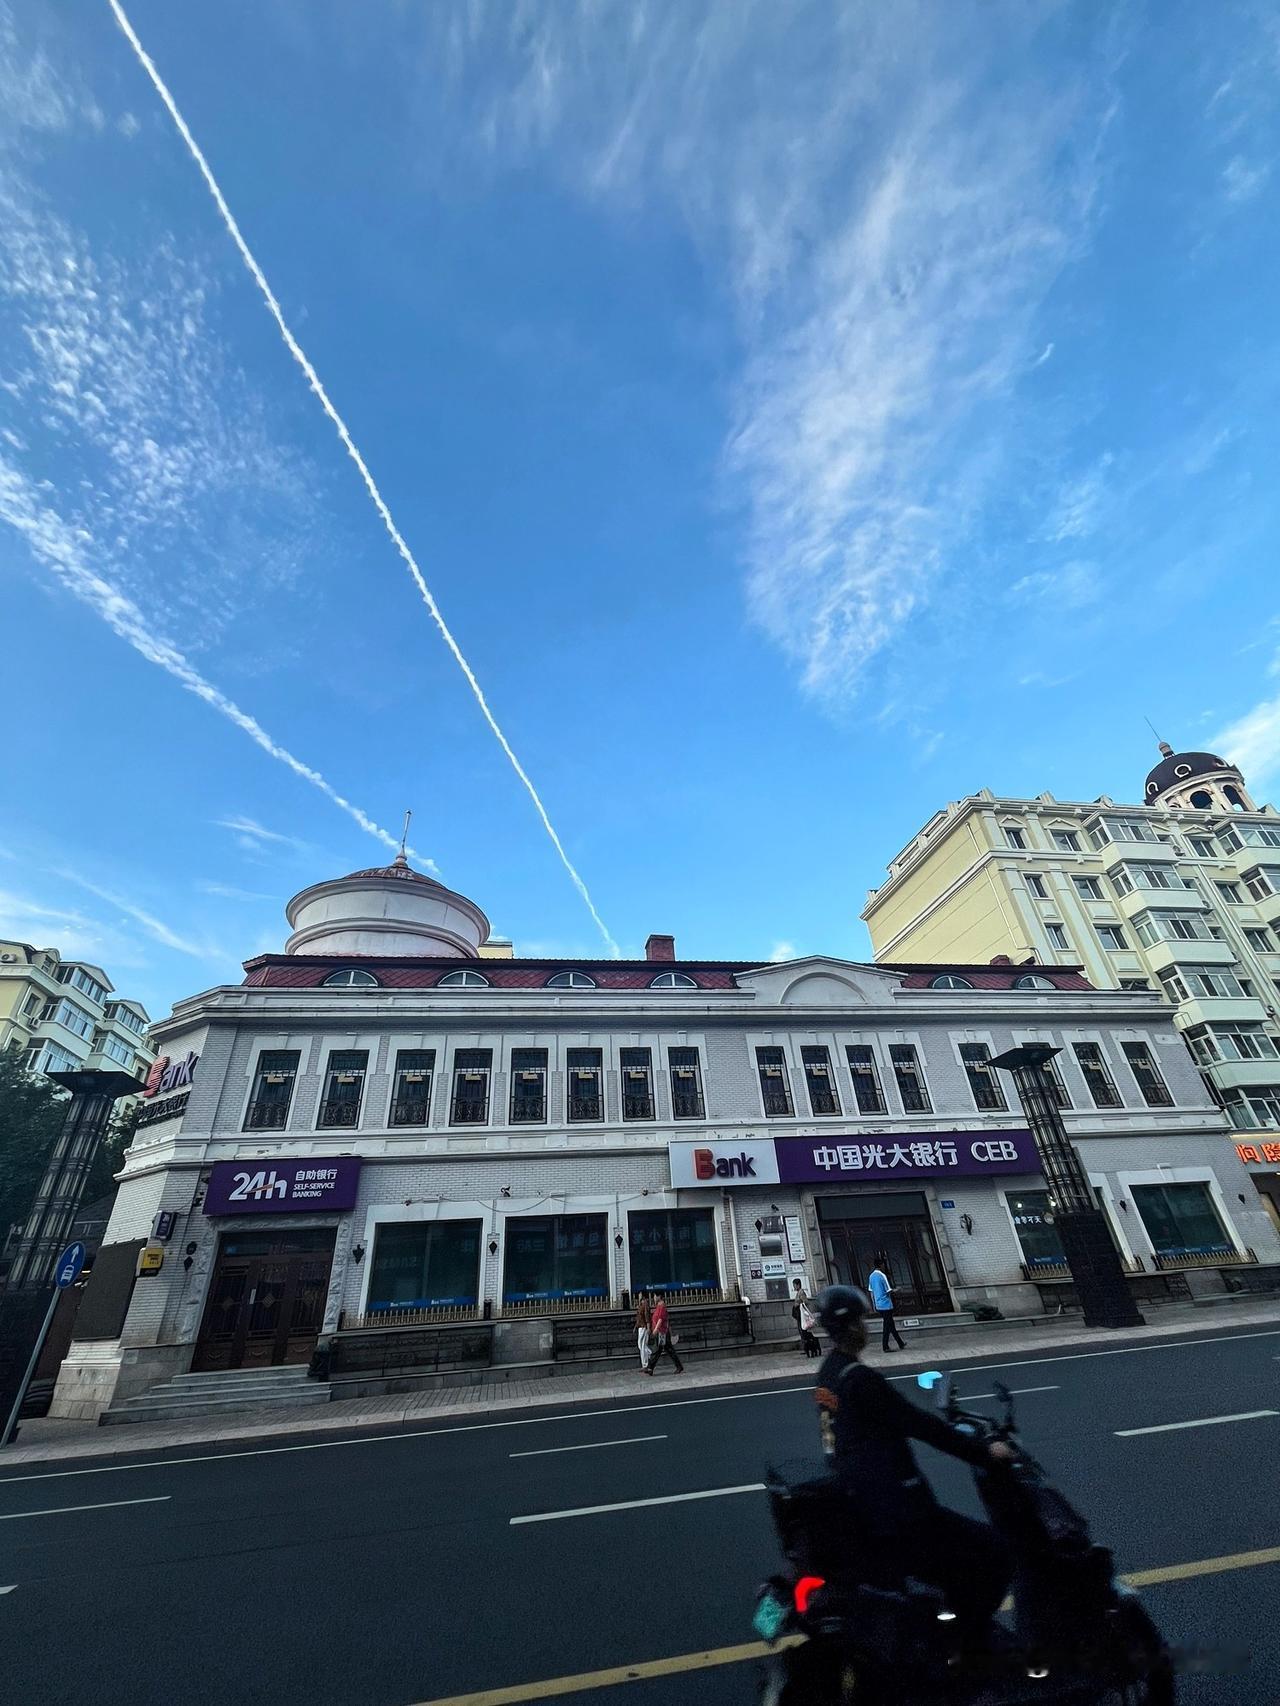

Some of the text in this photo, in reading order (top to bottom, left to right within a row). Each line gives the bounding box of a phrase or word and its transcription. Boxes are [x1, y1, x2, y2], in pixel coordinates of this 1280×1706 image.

[143, 1051, 199, 1098] Bank
[693, 1148, 757, 1180] Bank
[812, 1140, 1018, 1171] 中国光大银行 CEB
[228, 1170, 288, 1201] 24h
[293, 1182, 336, 1191] SELF-SERVICE
[295, 1168, 338, 1181] 自助银行
[292, 1190, 322, 1198] BANKING
